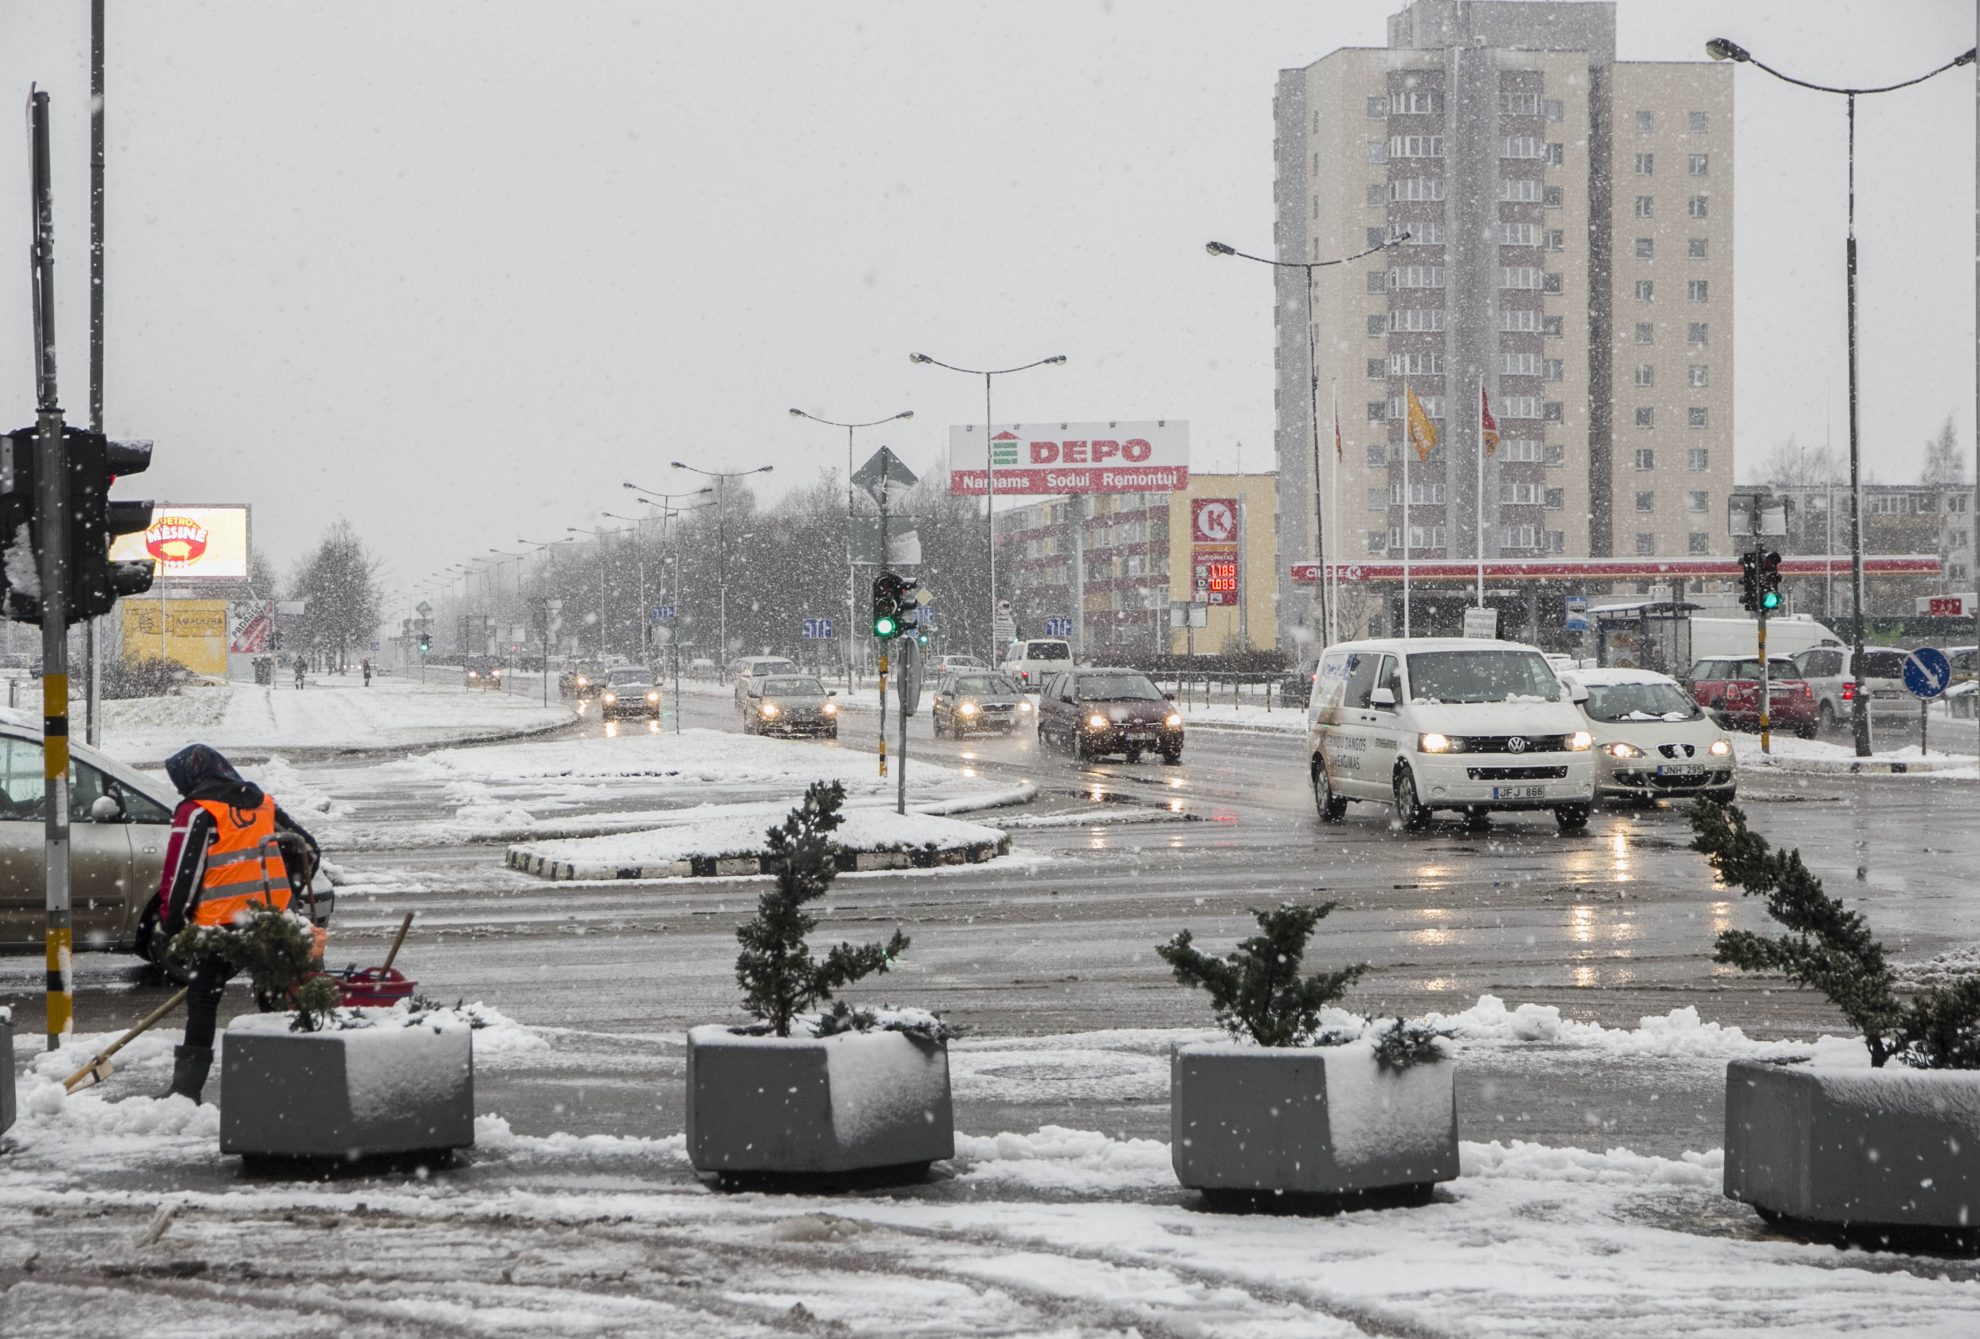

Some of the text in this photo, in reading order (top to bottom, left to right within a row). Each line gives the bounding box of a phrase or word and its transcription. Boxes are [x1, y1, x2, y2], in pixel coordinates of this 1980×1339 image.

[1030, 438, 1152, 464] DEPO
[1207, 510, 1227, 532] K
[1664, 766, 1682, 775] JNH
[1526, 787, 1543, 797] 866
